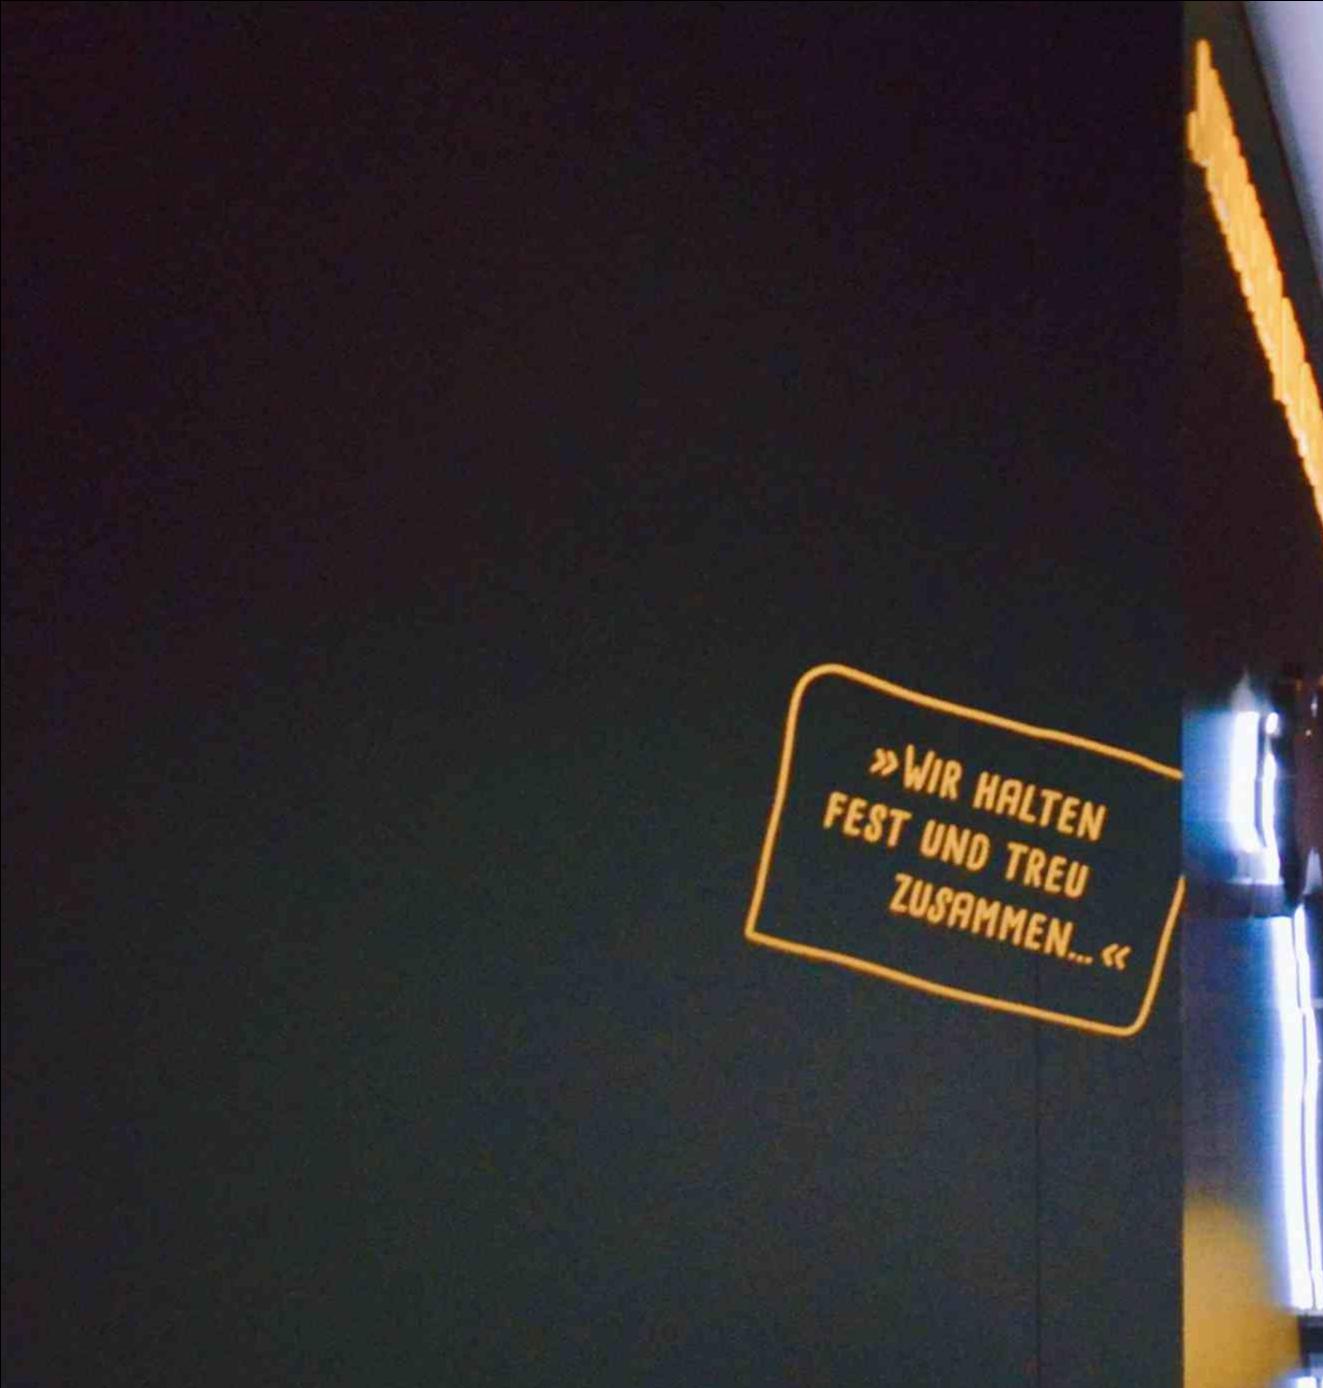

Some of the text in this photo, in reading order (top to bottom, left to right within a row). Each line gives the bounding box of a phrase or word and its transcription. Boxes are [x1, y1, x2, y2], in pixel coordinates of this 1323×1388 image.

[822, 790, 1090, 900] FEST UND TREU
[973, 772, 1108, 841] HALTEN
